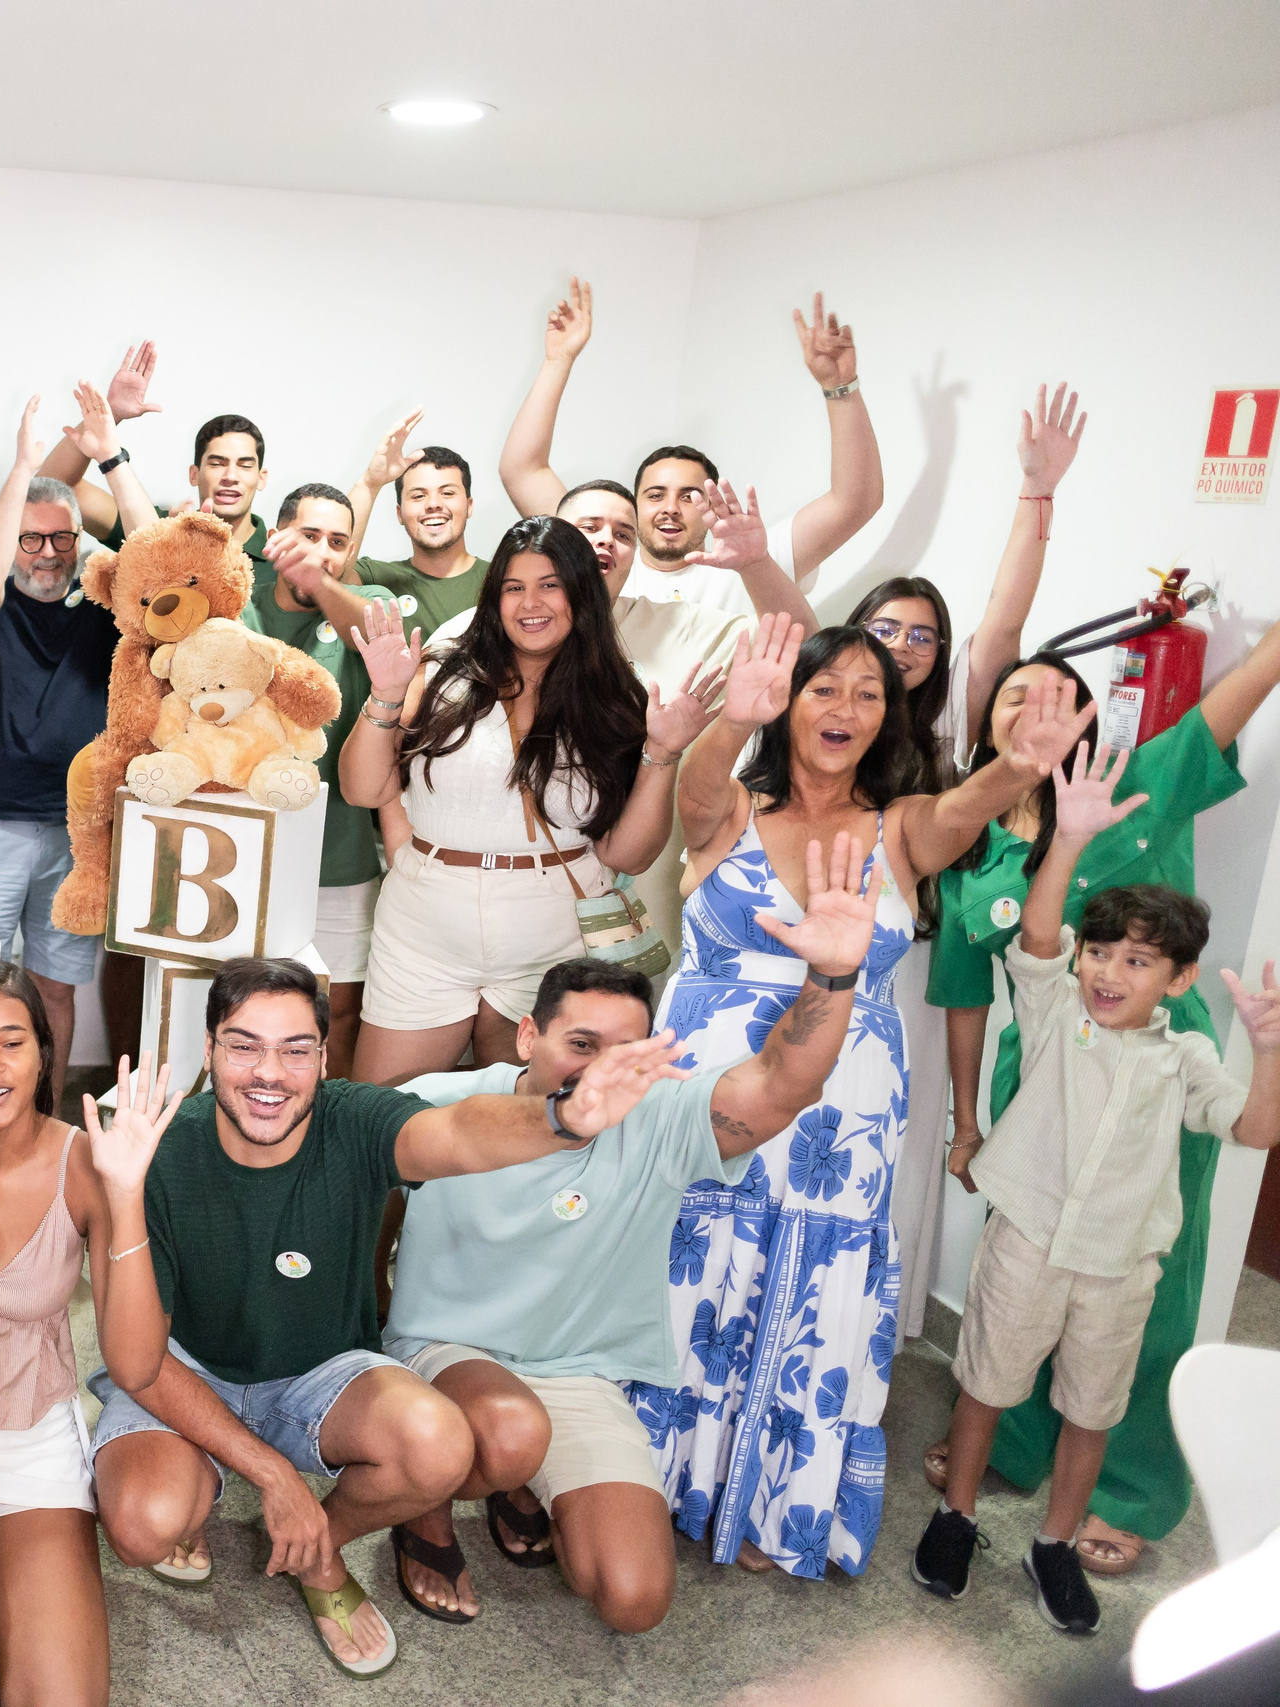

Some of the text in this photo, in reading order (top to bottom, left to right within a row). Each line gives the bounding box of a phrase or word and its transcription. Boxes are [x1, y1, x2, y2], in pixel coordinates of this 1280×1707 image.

[1201, 462, 1267, 477] EXTINTOR
[1196, 476, 1264, 495] PÓ QUÍMICO
[133, 814, 239, 943] B
